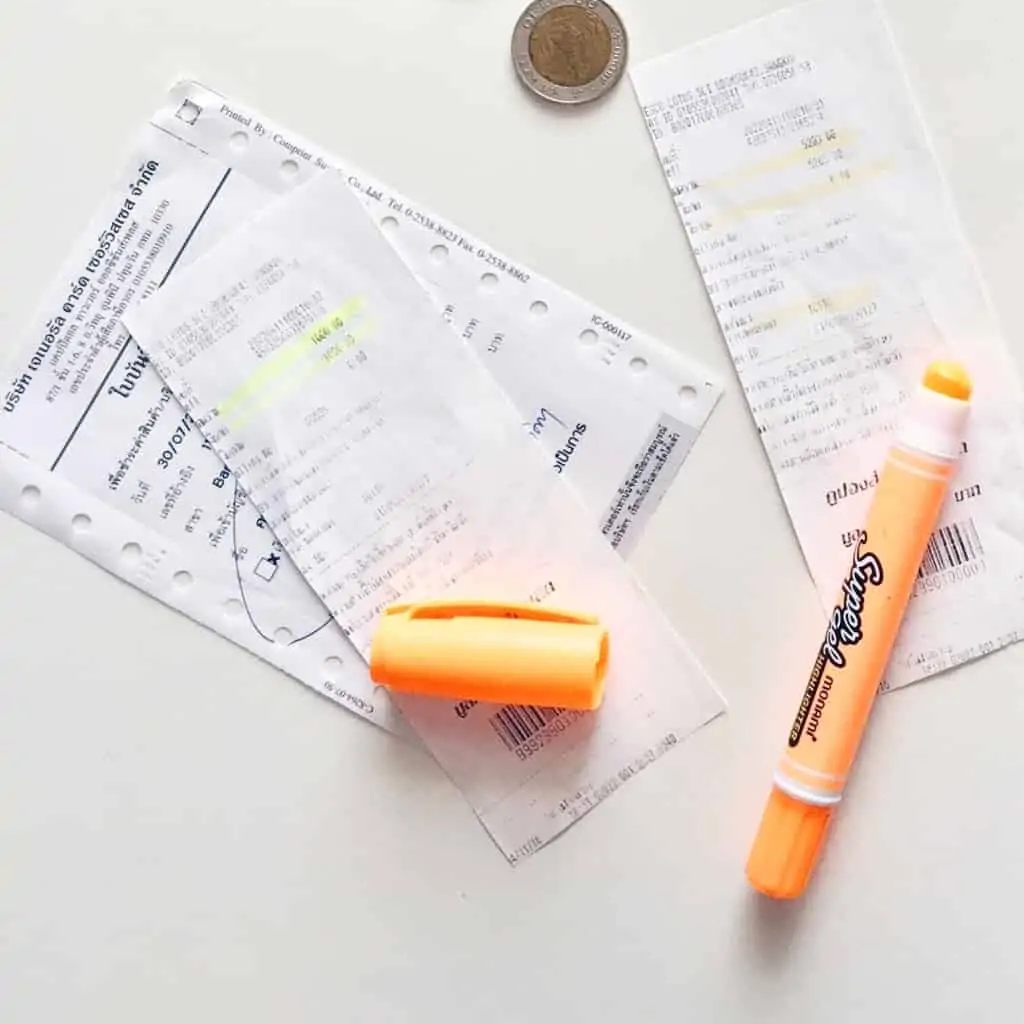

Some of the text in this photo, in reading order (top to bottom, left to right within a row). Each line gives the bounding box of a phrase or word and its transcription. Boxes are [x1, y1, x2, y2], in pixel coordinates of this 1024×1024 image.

[219, 103, 251, 127] Printed
[254, 122, 266, 137] By
[0, 369, 34, 414] บริษัท
[24, 312, 67, 373] เจเนอรัล
[125, 155, 160, 198] จำกัด
[107, 342, 154, 402] ใบบัน
[840, 530, 883, 646] Super
[806, 675, 834, 741] monami
